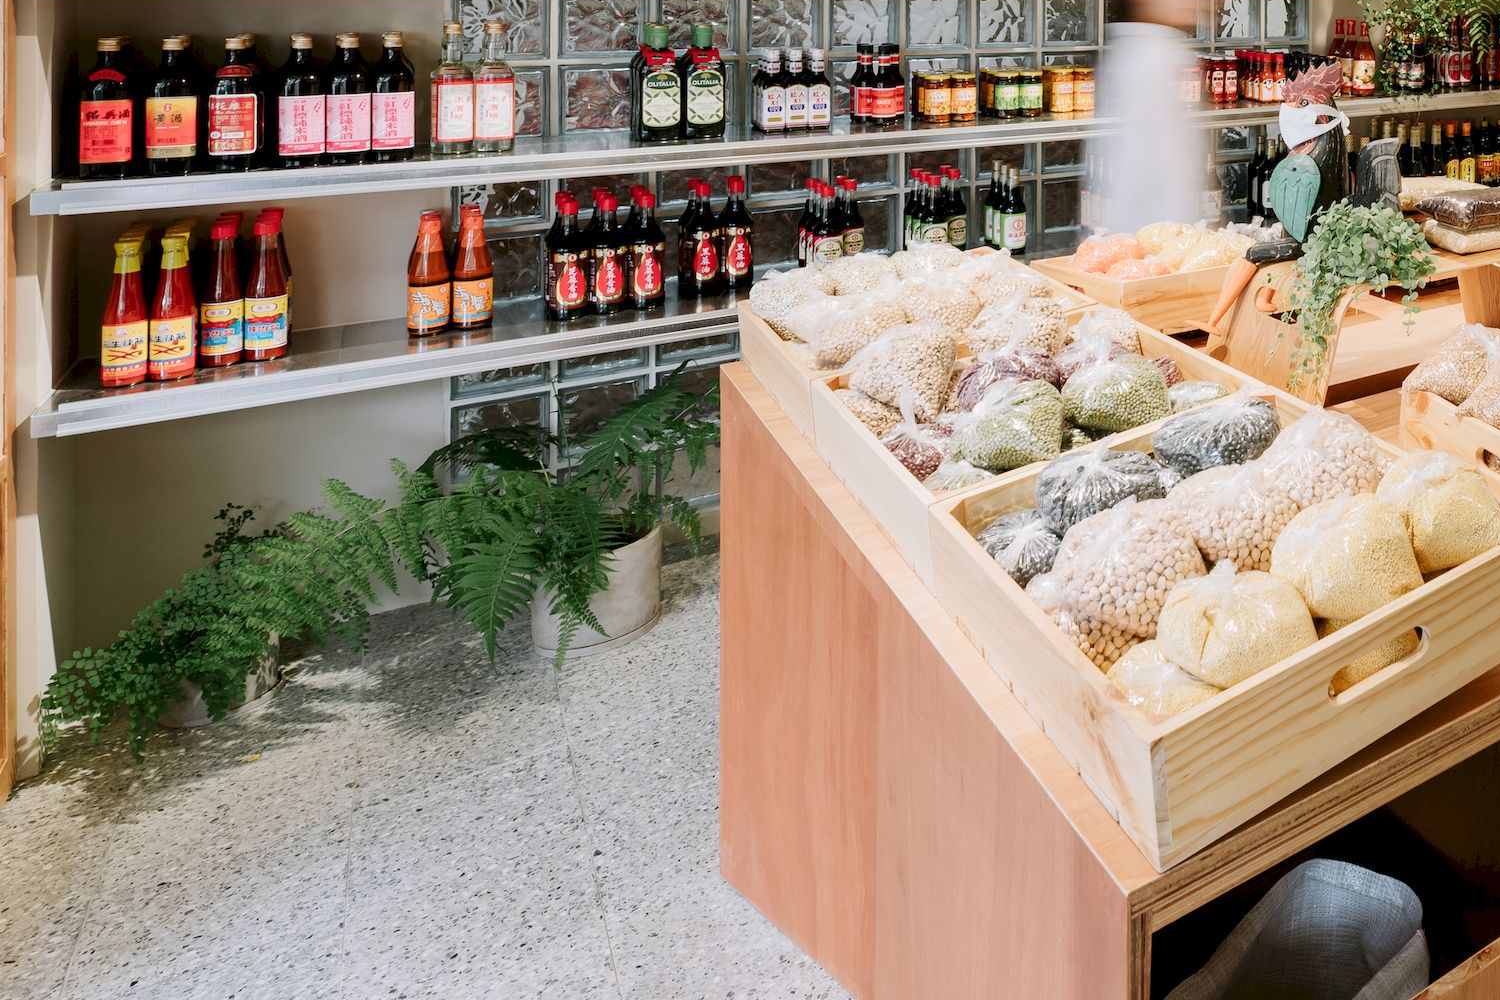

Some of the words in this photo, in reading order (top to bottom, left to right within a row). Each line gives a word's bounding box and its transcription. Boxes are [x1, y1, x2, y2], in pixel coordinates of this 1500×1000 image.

[293, 103, 308, 142] 紅標純米酒
[339, 101, 353, 140] 紅標純米酒
[384, 100, 398, 137] 紅標純米酒
